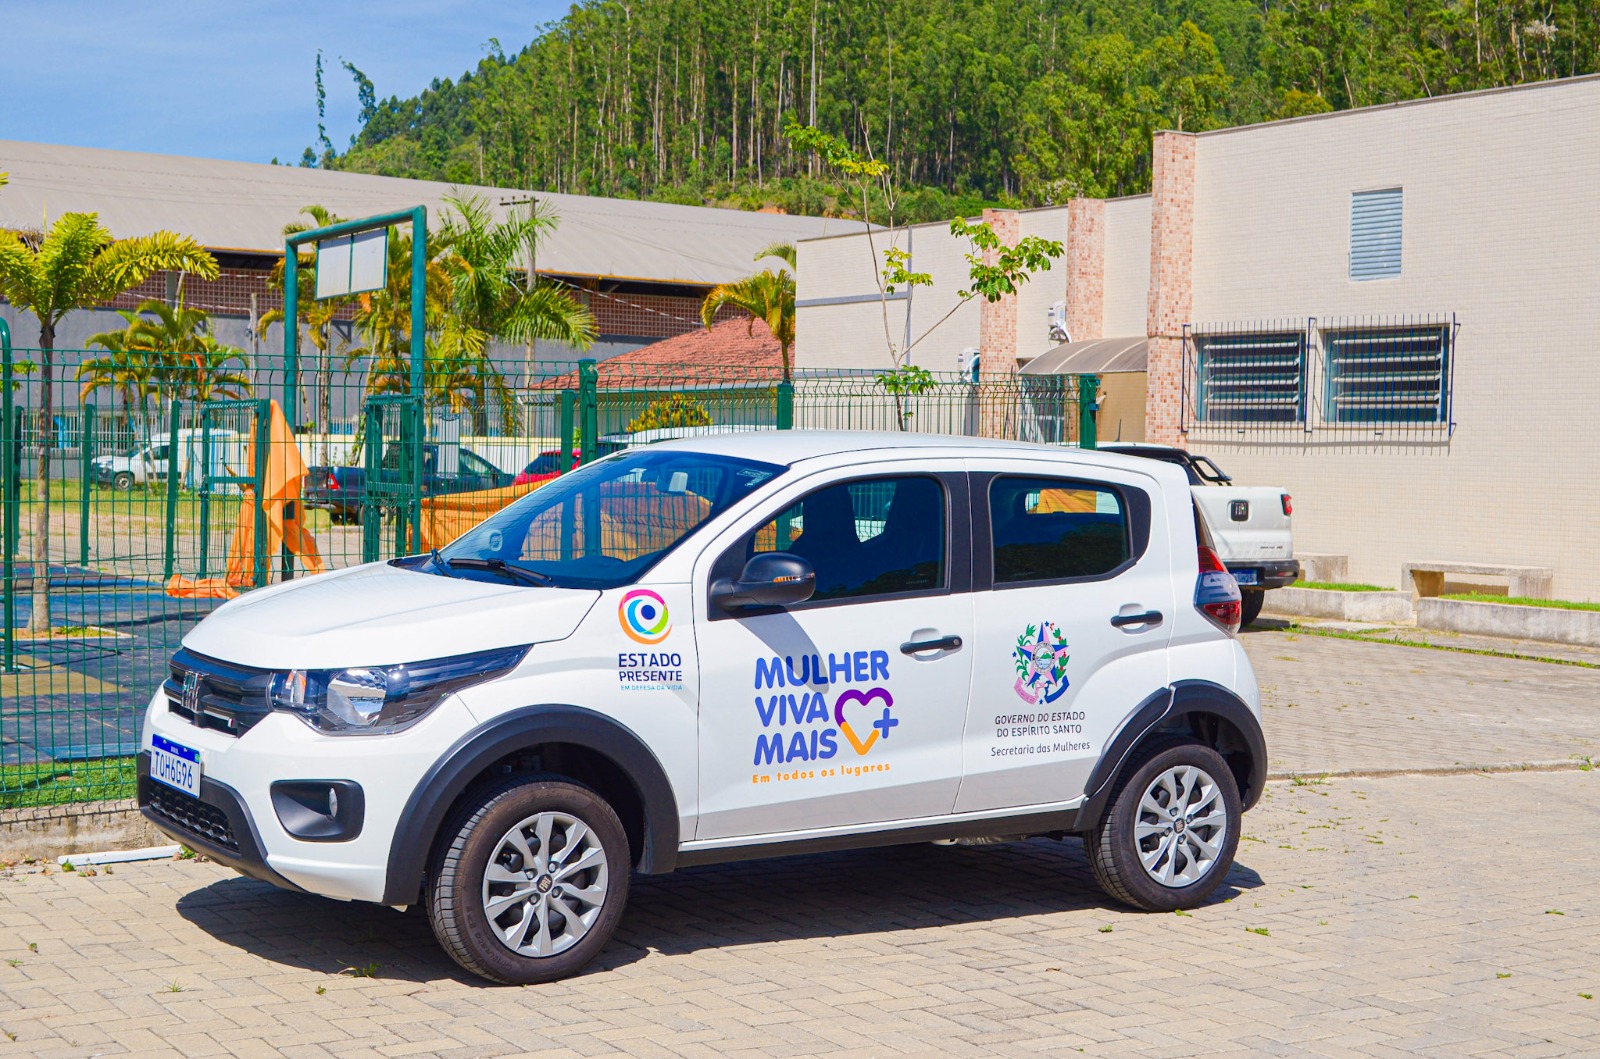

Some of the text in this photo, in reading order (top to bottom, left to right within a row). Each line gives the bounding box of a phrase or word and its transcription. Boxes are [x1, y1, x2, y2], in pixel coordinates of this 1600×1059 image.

[618, 653, 682, 668] ESTADO
[618, 670, 683, 682] PRESENTE
[754, 650, 890, 690] MULHER
[754, 691, 830, 728] VIVA
[994, 711, 1086, 725] GOVERNO DO ESTADO
[996, 724, 1082, 738] DO ESPÍRITO SANTO
[753, 728, 838, 766] MAIS
[991, 741, 1091, 757] Secretaria das Mulheres
[155, 751, 193, 789] TOH6G96
[752, 763, 891, 784] Em todos os lugares
